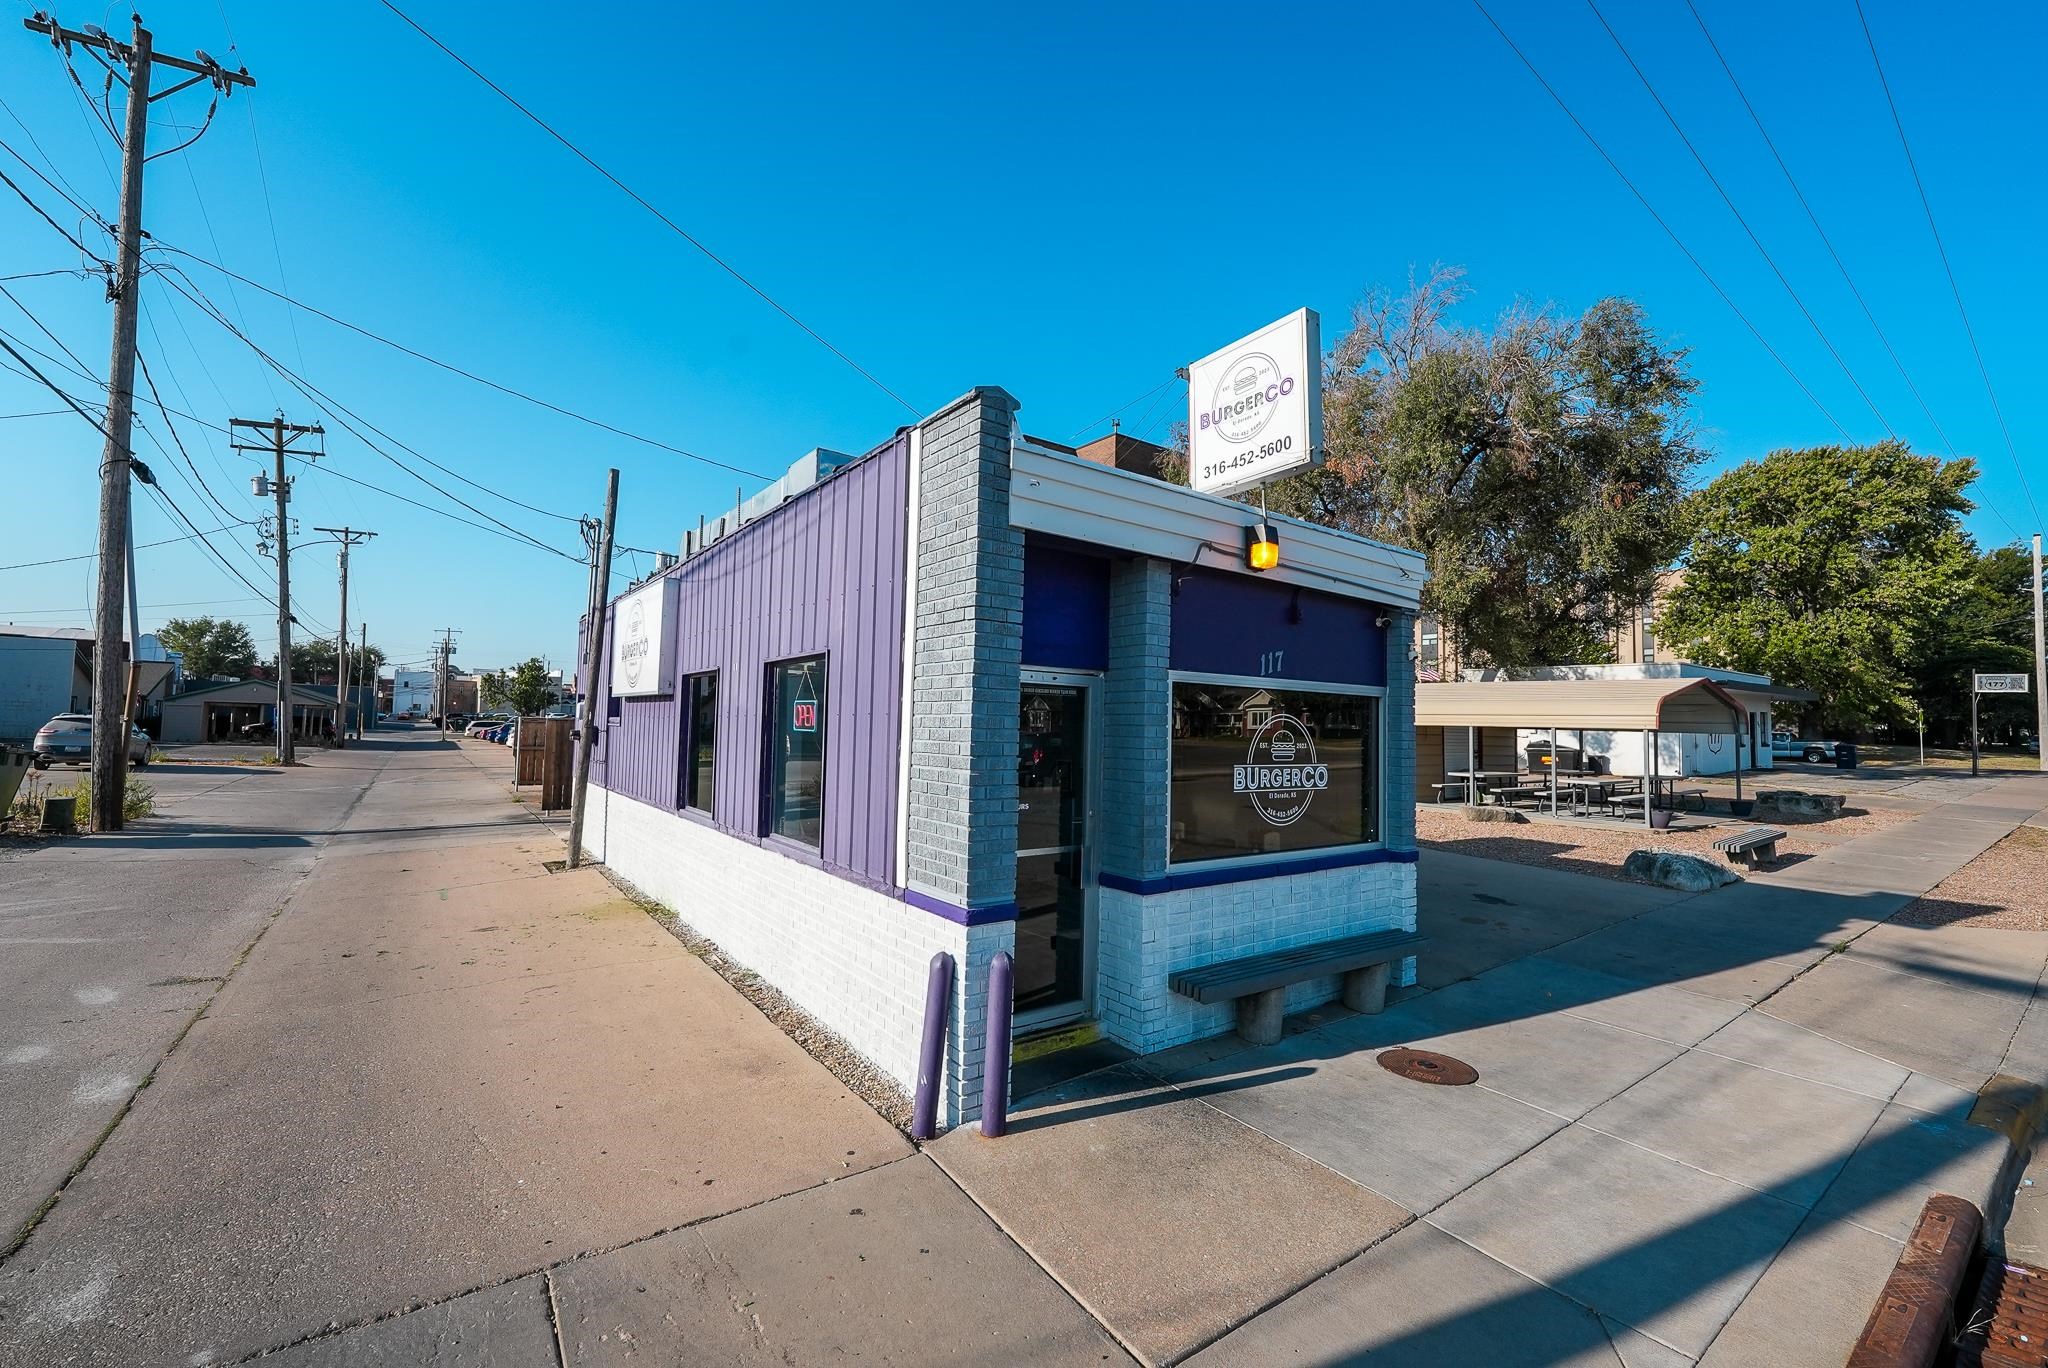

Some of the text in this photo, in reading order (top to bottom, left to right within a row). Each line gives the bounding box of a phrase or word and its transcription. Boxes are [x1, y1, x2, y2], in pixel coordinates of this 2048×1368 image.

[1200, 377, 1294, 430] BURGERCO
[1203, 435, 1292, 479] 316-452-5600
[1260, 650, 1284, 676] 117
[795, 704, 815, 727] OPEN
[1234, 766, 1328, 790] BURGERCO
